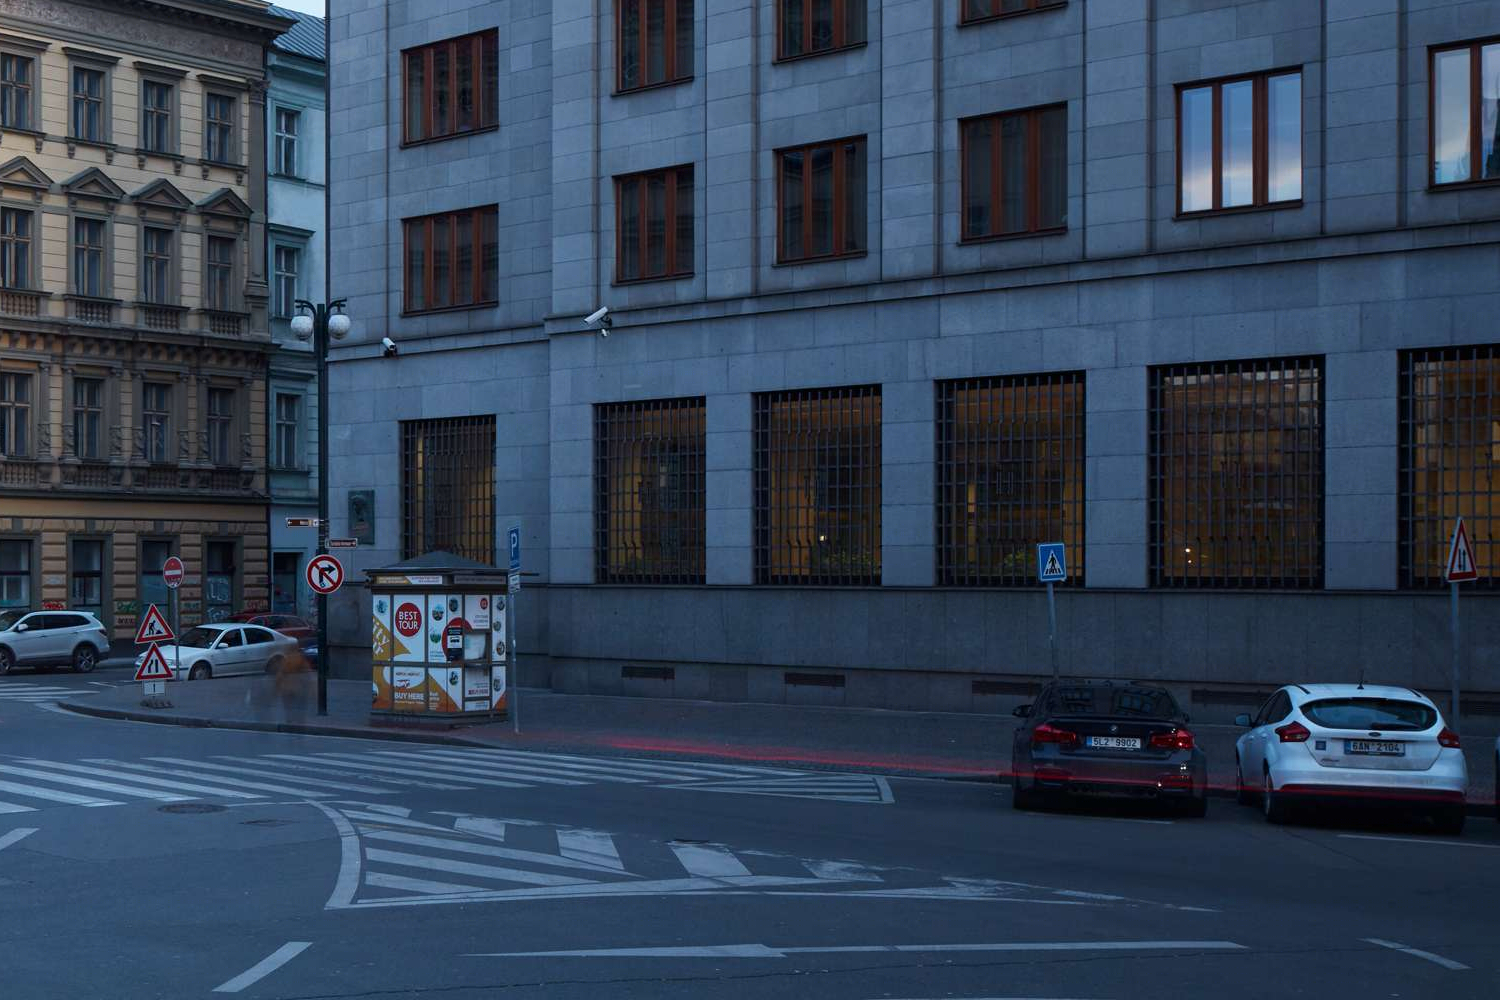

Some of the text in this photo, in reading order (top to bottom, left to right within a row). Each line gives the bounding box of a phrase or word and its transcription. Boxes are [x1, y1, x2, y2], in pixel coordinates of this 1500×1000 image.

[398, 611, 417, 621] BEST
[398, 620, 419, 630] TOUR
[1093, 737, 1109, 746] 5L2
[1376, 743, 1401, 753] 2104
